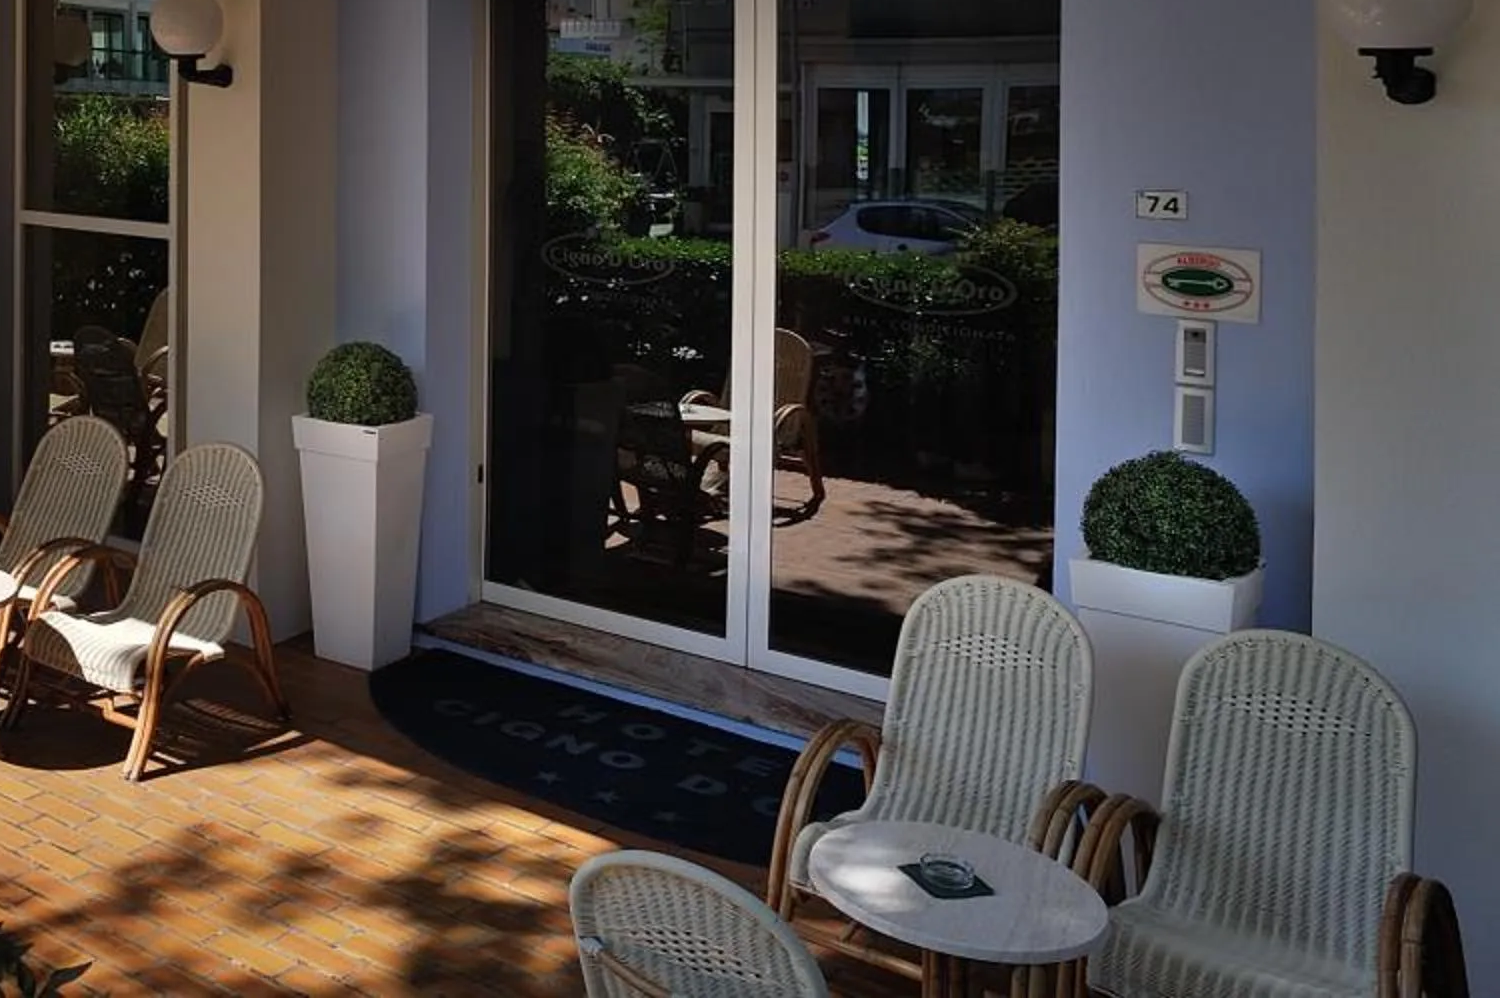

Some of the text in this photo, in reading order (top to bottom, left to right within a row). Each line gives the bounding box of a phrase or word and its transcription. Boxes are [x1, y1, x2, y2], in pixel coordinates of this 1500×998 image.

[1146, 195, 1180, 214] 74
[432, 698, 648, 770] CIGNO
[554, 703, 786, 778] HOTE
